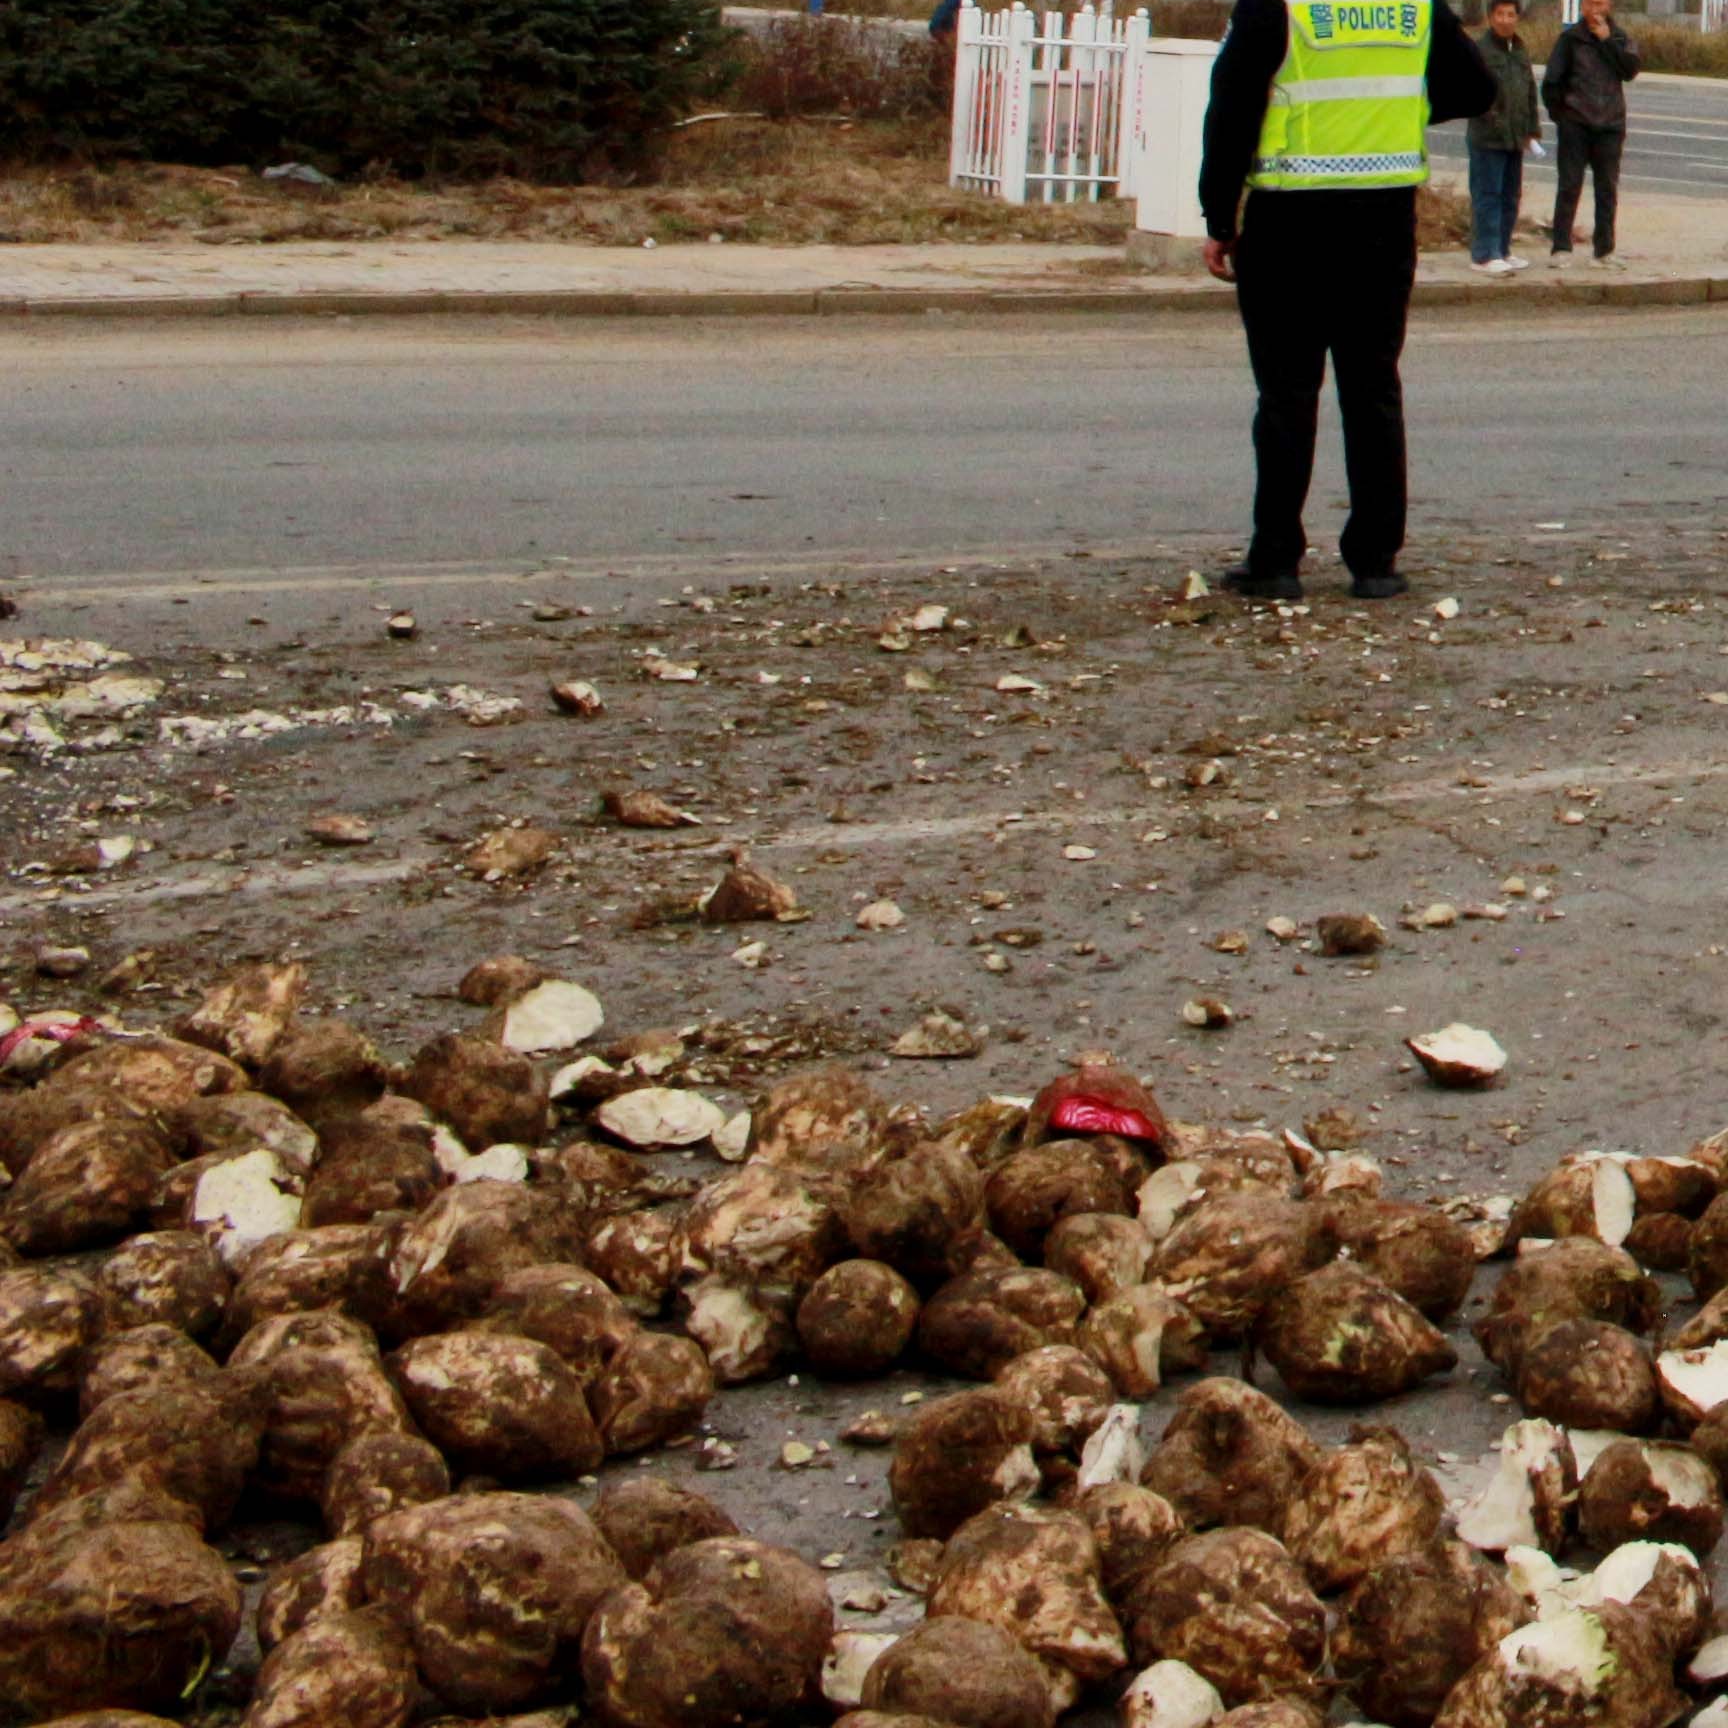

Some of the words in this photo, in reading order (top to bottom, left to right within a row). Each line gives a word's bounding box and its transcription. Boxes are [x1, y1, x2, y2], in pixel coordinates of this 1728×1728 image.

[1310, 3, 1334, 39] 警
[1338, 6, 1396, 30] POLICE
[1400, 2, 1417, 37] 察
